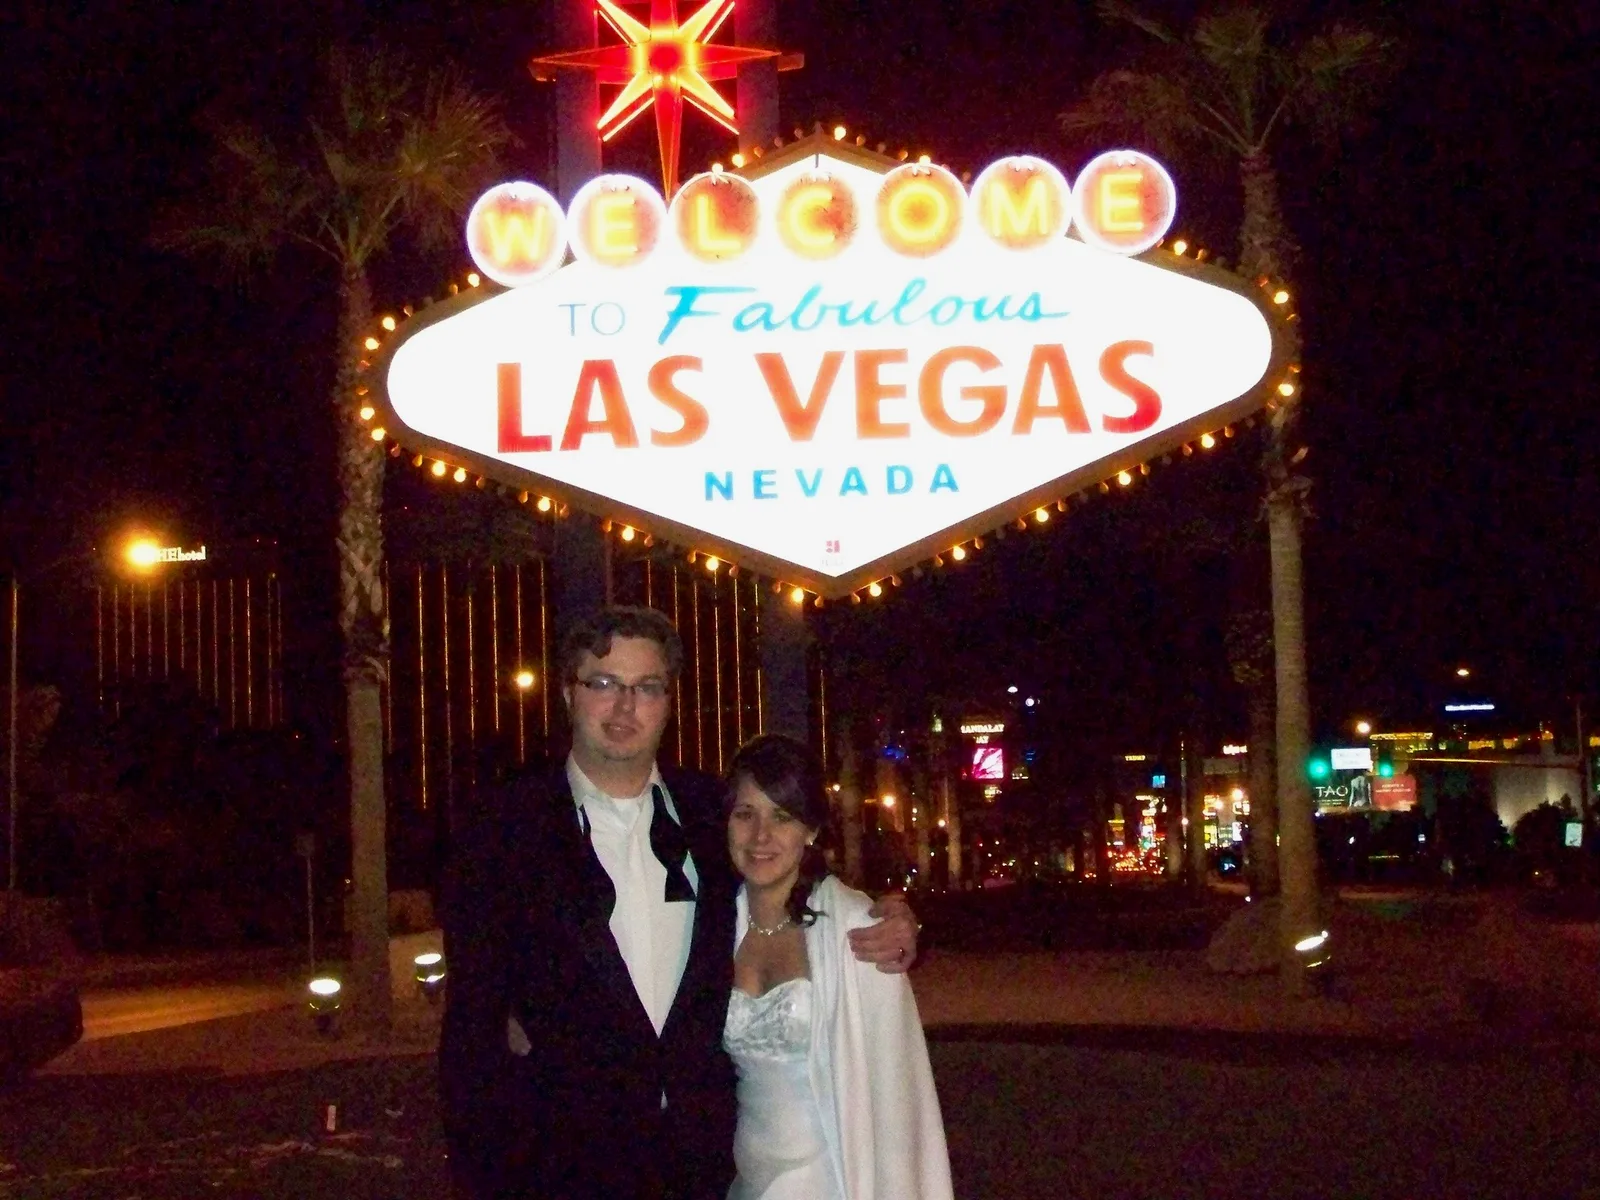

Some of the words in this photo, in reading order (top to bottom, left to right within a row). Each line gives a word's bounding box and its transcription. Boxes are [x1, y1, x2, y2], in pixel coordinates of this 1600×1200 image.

[483, 171, 1145, 265] WELCOME
[558, 302, 627, 336] TO
[657, 277, 1069, 345] Fabulous
[496, 355, 709, 454] LAS
[754, 339, 1163, 442] VEGAS
[704, 463, 959, 501] NEVADA
[1315, 785, 1349, 797] TAO
